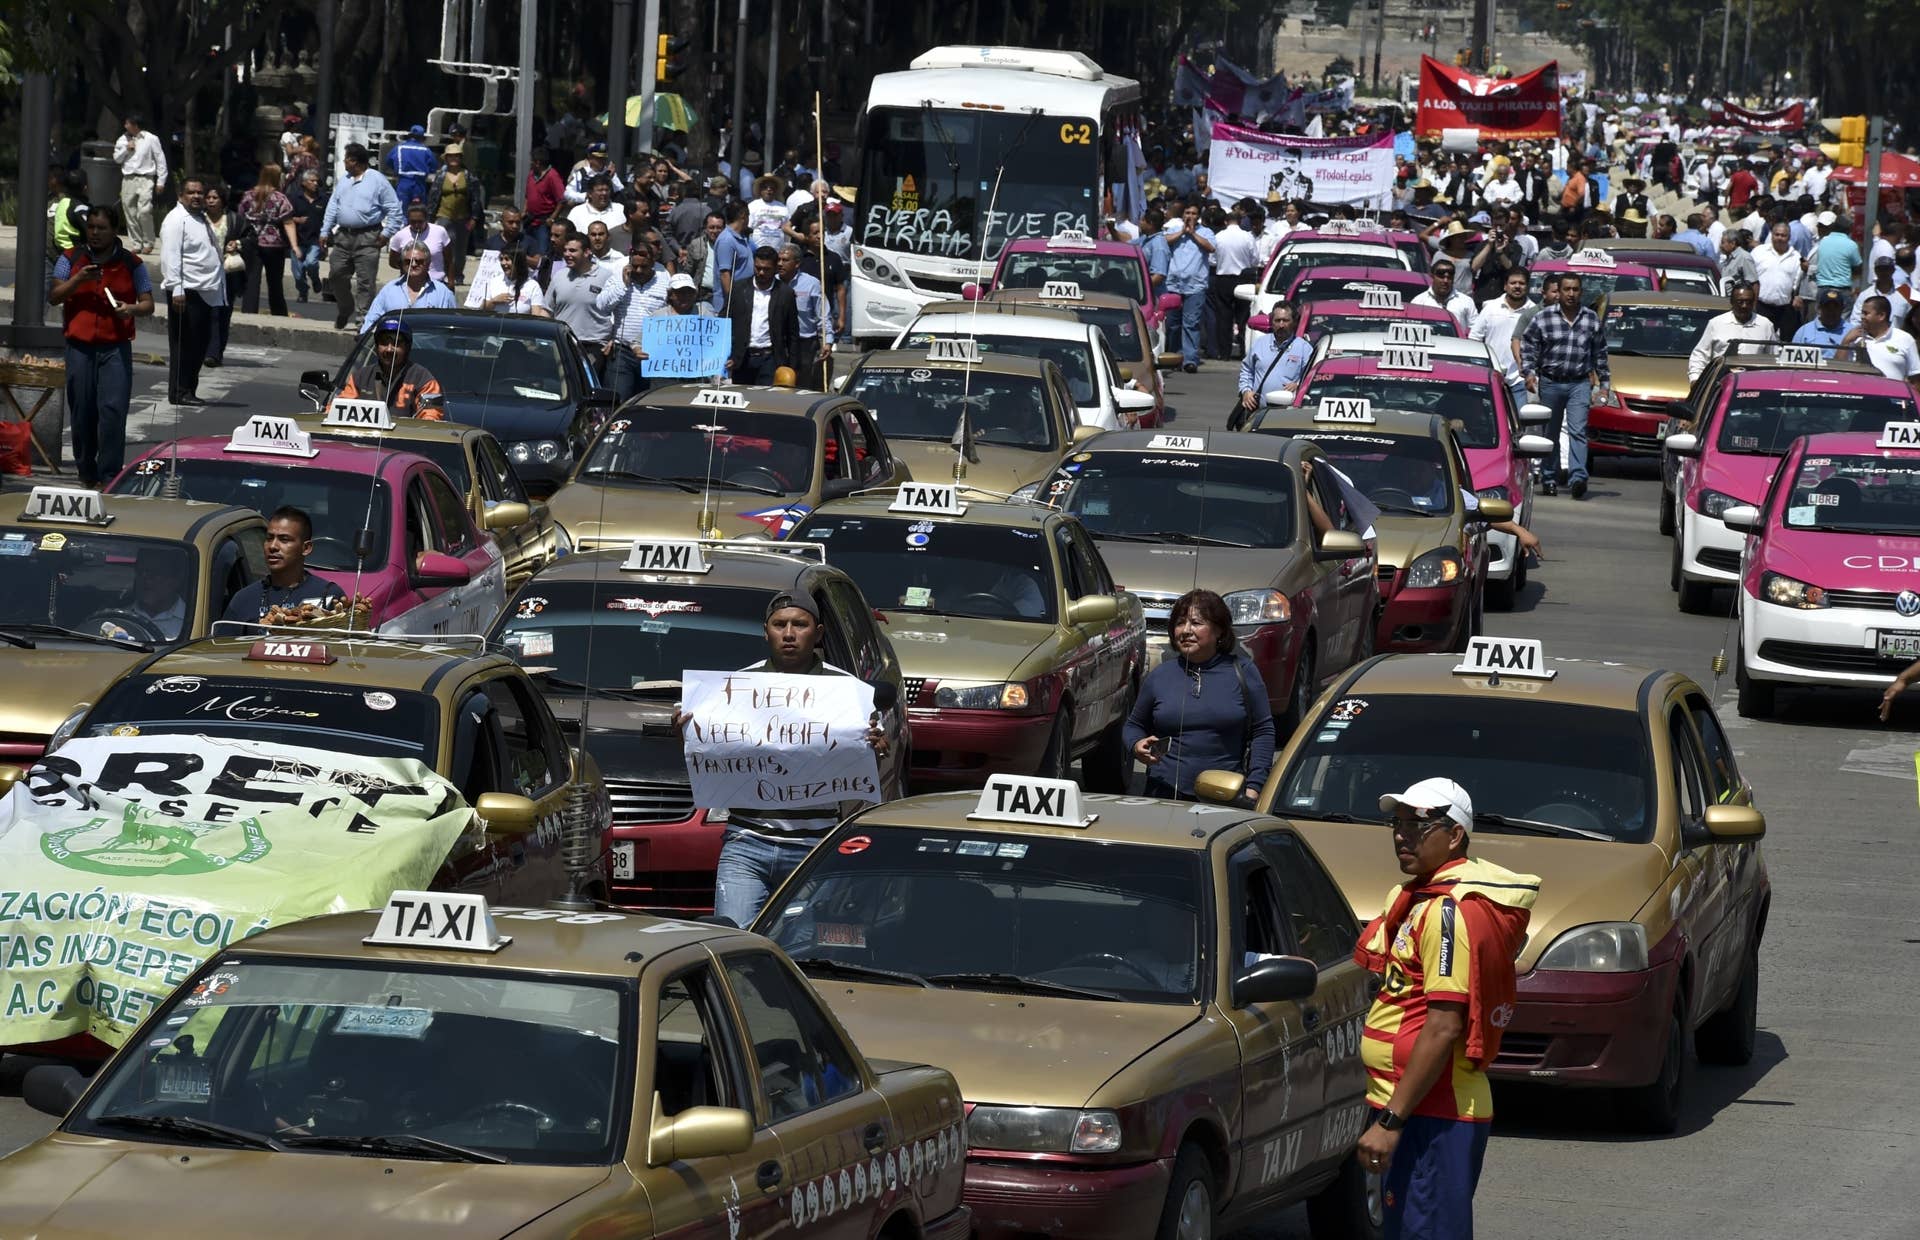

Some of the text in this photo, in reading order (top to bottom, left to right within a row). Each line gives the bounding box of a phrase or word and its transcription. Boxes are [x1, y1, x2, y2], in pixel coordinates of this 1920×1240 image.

[1434, 100, 1456, 110] LOS
[1461, 101, 1494, 111] TAXIS
[1498, 101, 1543, 111] PIRATAS
[1060, 124, 1091, 144] C-2
[1225, 147, 1280, 162] #YoLegal
[1316, 168, 1372, 183] #TodosLegales
[868, 204, 953, 232] FUERA
[1330, 221, 1347, 229] TAXI
[1357, 220, 1373, 228] TAXI
[863, 223, 973, 257] PIRATAS
[1063, 232, 1082, 240] TAXI
[1584, 251, 1602, 259] TAXI
[1047, 285, 1077, 297] TAXI
[1367, 292, 1397, 306] TAXI
[658, 335, 714, 347] LEGALES
[1392, 326, 1427, 342] TAXI
[676, 347, 692, 357] VS
[936, 342, 973, 358] TAXI
[1386, 349, 1424, 367] TAXI
[1785, 348, 1819, 364] TAXI
[703, 393, 736, 405] TAXI
[335, 405, 380, 424] TAXI
[1325, 400, 1365, 419] TAXI
[252, 420, 289, 441] TAXI
[1292, 433, 1397, 445] espartacos
[1165, 436, 1191, 448] TAXI
[903, 487, 951, 508] TAXI
[1809, 494, 1839, 505] LIBRE
[37, 494, 92, 519] TAXI
[638, 544, 691, 570] TAXI
[1843, 555, 1920, 570] CD
[264, 643, 311, 657] TAXI
[1472, 642, 1536, 670] TAXI
[721, 675, 816, 710] FUERA
[690, 752, 788, 776] PANTERAS,
[757, 776, 876, 802] QUETZALES
[992, 783, 1066, 818] TAXI
[0, 887, 129, 925] ZACIÓN
[391, 900, 477, 941] TAXI
[60, 934, 203, 986] INDEPE
[7, 978, 64, 1016] A.C.
[1261, 1128, 1305, 1185] TAXI
